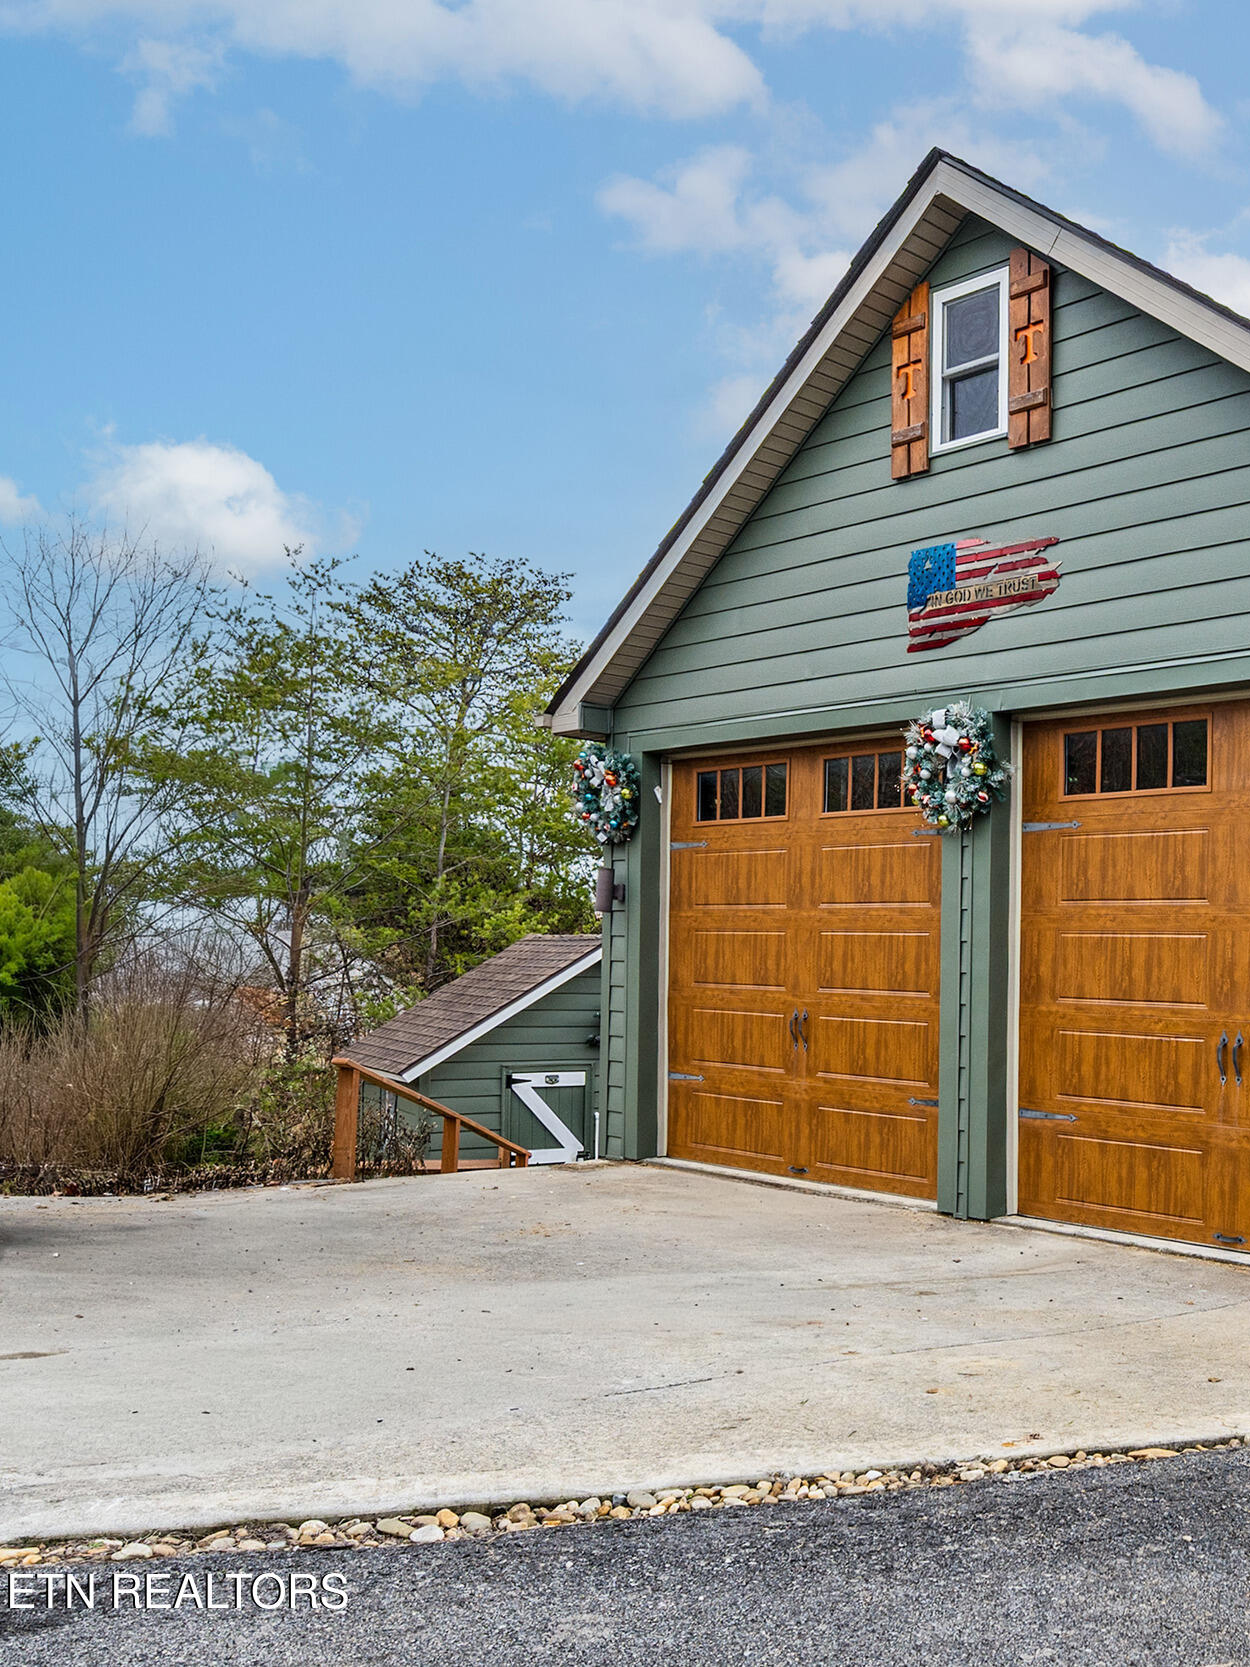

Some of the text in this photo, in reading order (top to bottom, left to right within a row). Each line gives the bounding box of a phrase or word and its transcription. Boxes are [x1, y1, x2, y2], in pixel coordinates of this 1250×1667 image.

[1013, 319, 1044, 365] T
[896, 358, 922, 401] T
[929, 576, 1038, 608] IN GOD WE TRUST
